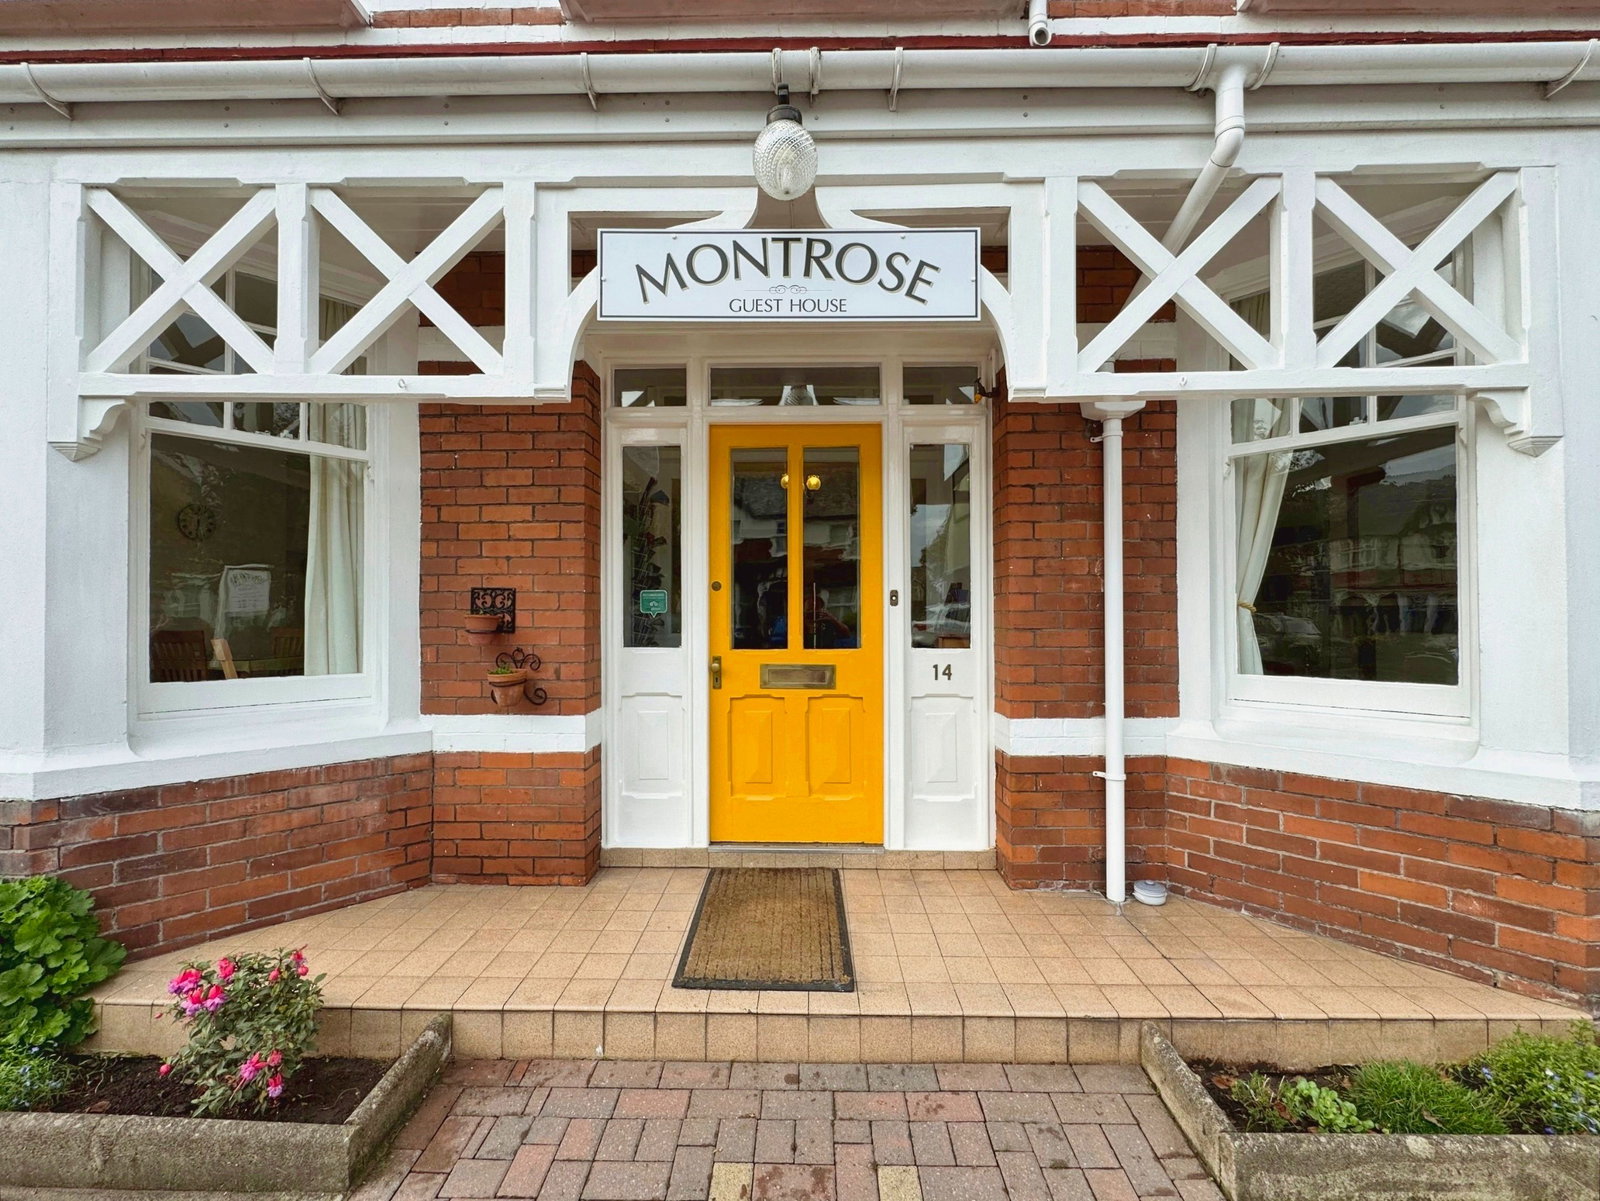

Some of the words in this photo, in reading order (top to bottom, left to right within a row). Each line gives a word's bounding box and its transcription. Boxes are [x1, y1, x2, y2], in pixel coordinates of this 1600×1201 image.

[635, 237, 941, 305] MONTROSE
[729, 298, 783, 313] GUEST
[790, 298, 847, 313] HOUSE
[932, 663, 953, 681] 14
